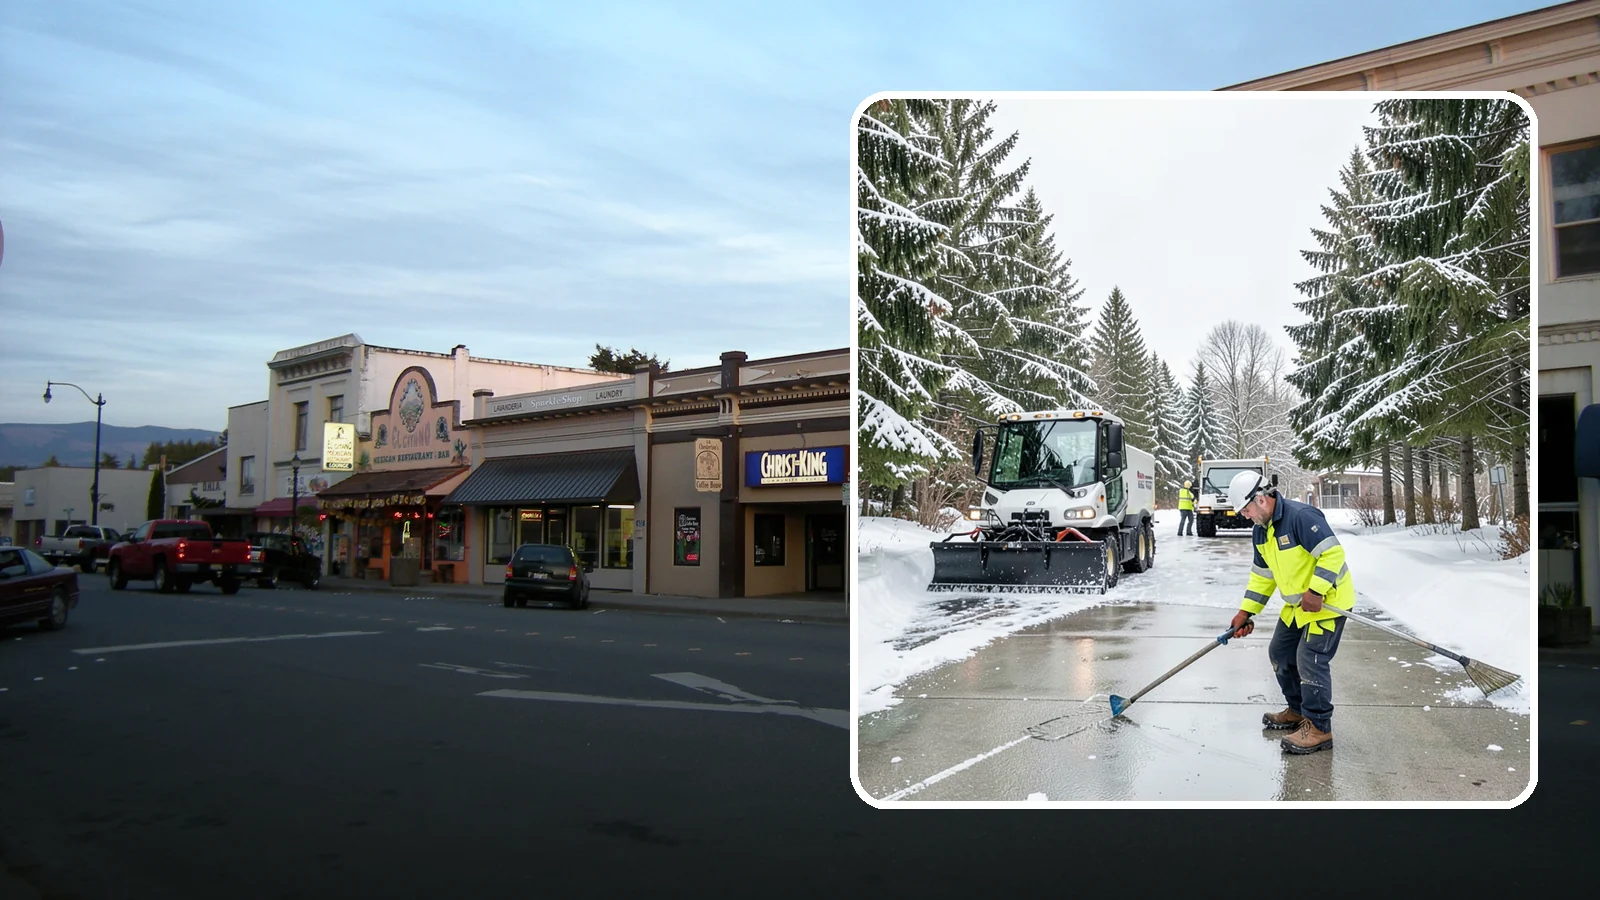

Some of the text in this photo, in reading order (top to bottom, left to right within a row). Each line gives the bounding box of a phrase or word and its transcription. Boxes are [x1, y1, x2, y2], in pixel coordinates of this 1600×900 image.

[531, 394, 583, 409] Sparkle Shop
[596, 389, 624, 400] LAUNDRY
[494, 402, 523, 413] LAVANDERIA
[374, 455, 397, 465] MEXICAN
[397, 451, 434, 463] RESTAURANT
[437, 450, 450, 460] BAR
[761, 450, 828, 478] CHRIST KING
